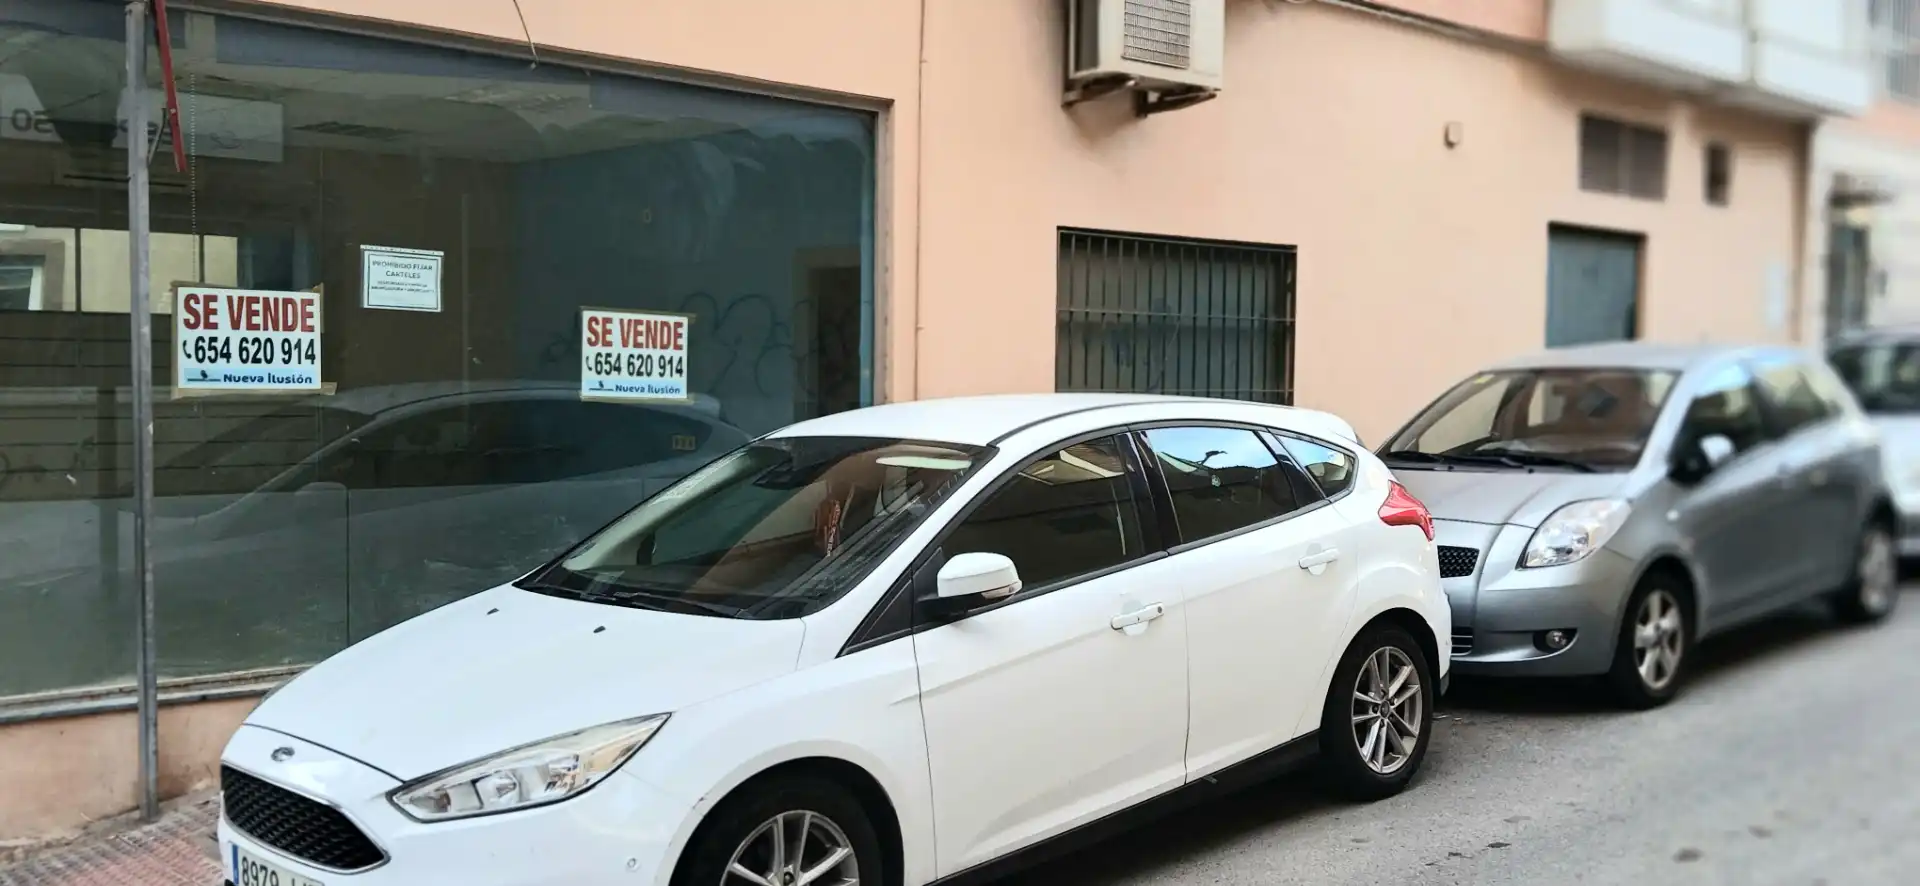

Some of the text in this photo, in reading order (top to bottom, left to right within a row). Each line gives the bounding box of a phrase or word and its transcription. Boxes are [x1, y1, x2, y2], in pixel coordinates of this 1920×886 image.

[183, 293, 315, 332] SE VENDE
[587, 316, 684, 350] SE VENDE
[194, 336, 316, 365] 654 620 914
[223, 372, 313, 384] Nueva Ilusión
[595, 352, 683, 378] 654 620 914
[615, 384, 645, 393] Nueva
